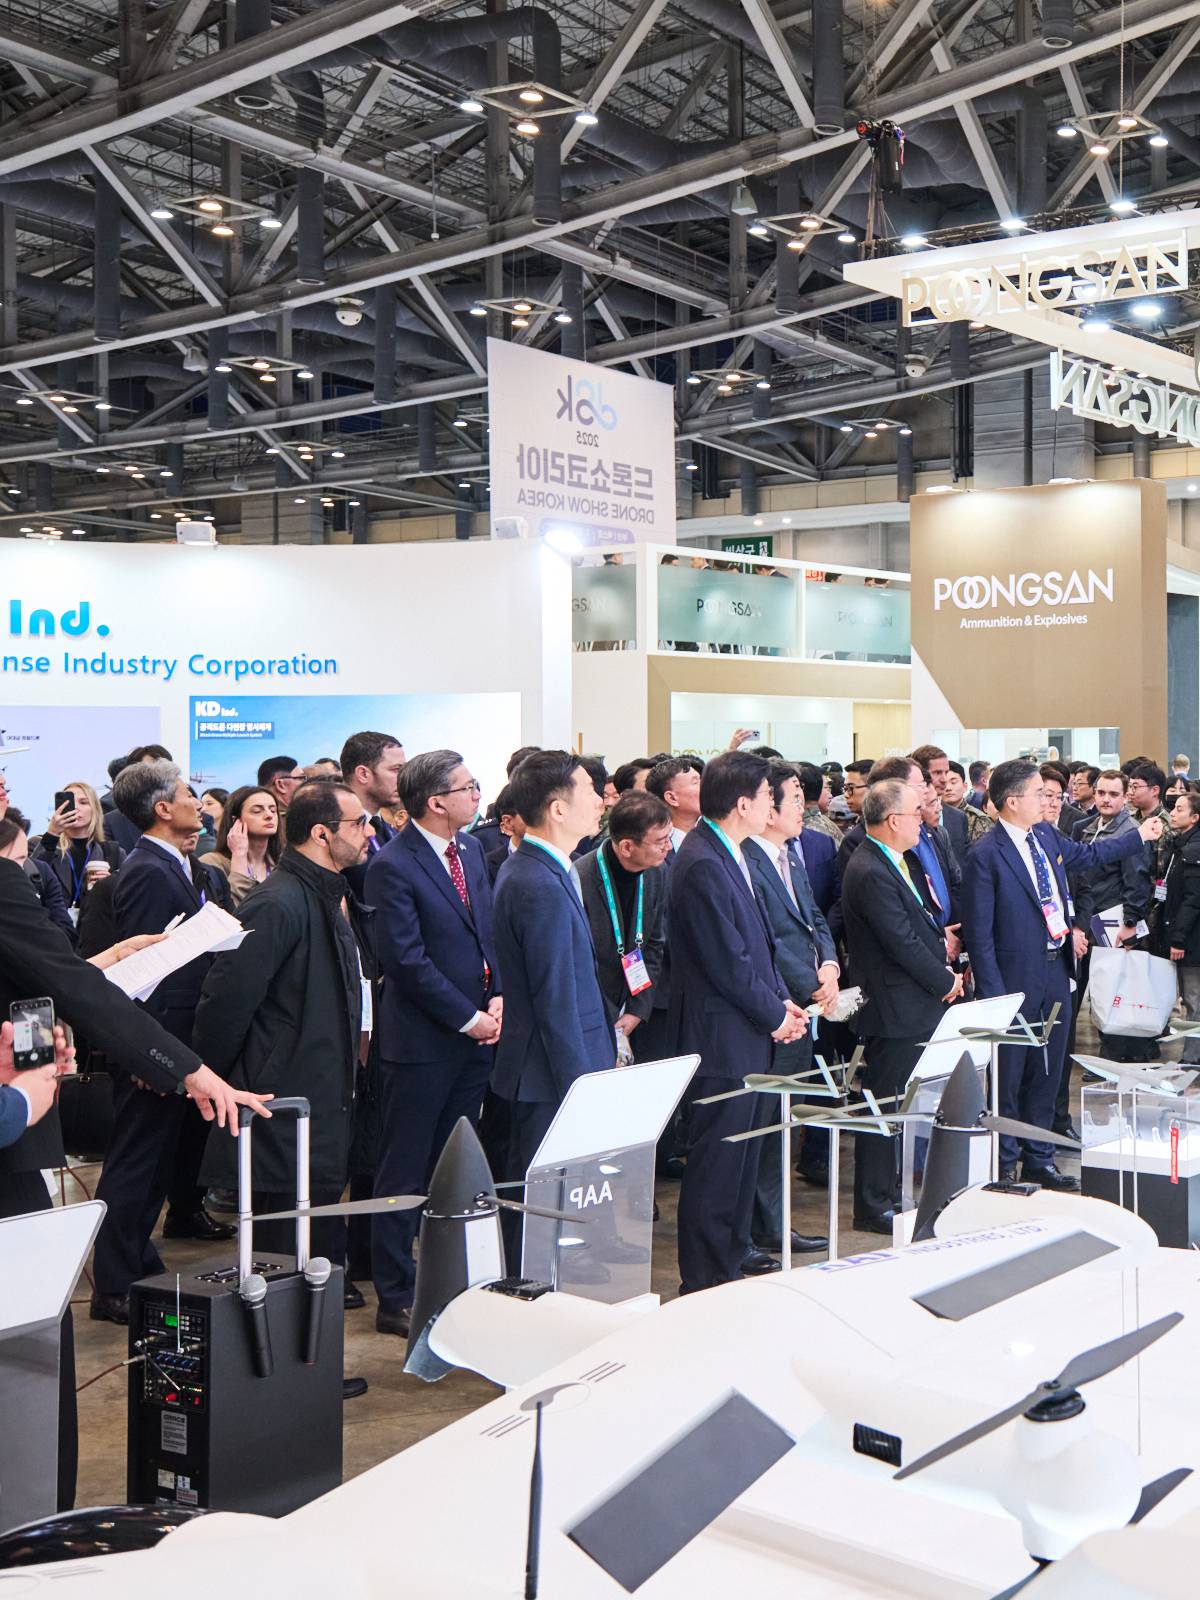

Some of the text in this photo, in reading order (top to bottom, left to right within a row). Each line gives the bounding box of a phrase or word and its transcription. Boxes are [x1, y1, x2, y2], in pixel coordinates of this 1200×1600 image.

[902, 236, 1188, 327] POONGSAN
[934, 567, 1113, 610] POONGSAN
[9, 599, 110, 637] Ind.
[960, 613, 1088, 629] Ammunition & Explosives
[2, 652, 338, 680] nse Industry Corporation
[195, 701, 220, 717] KD
